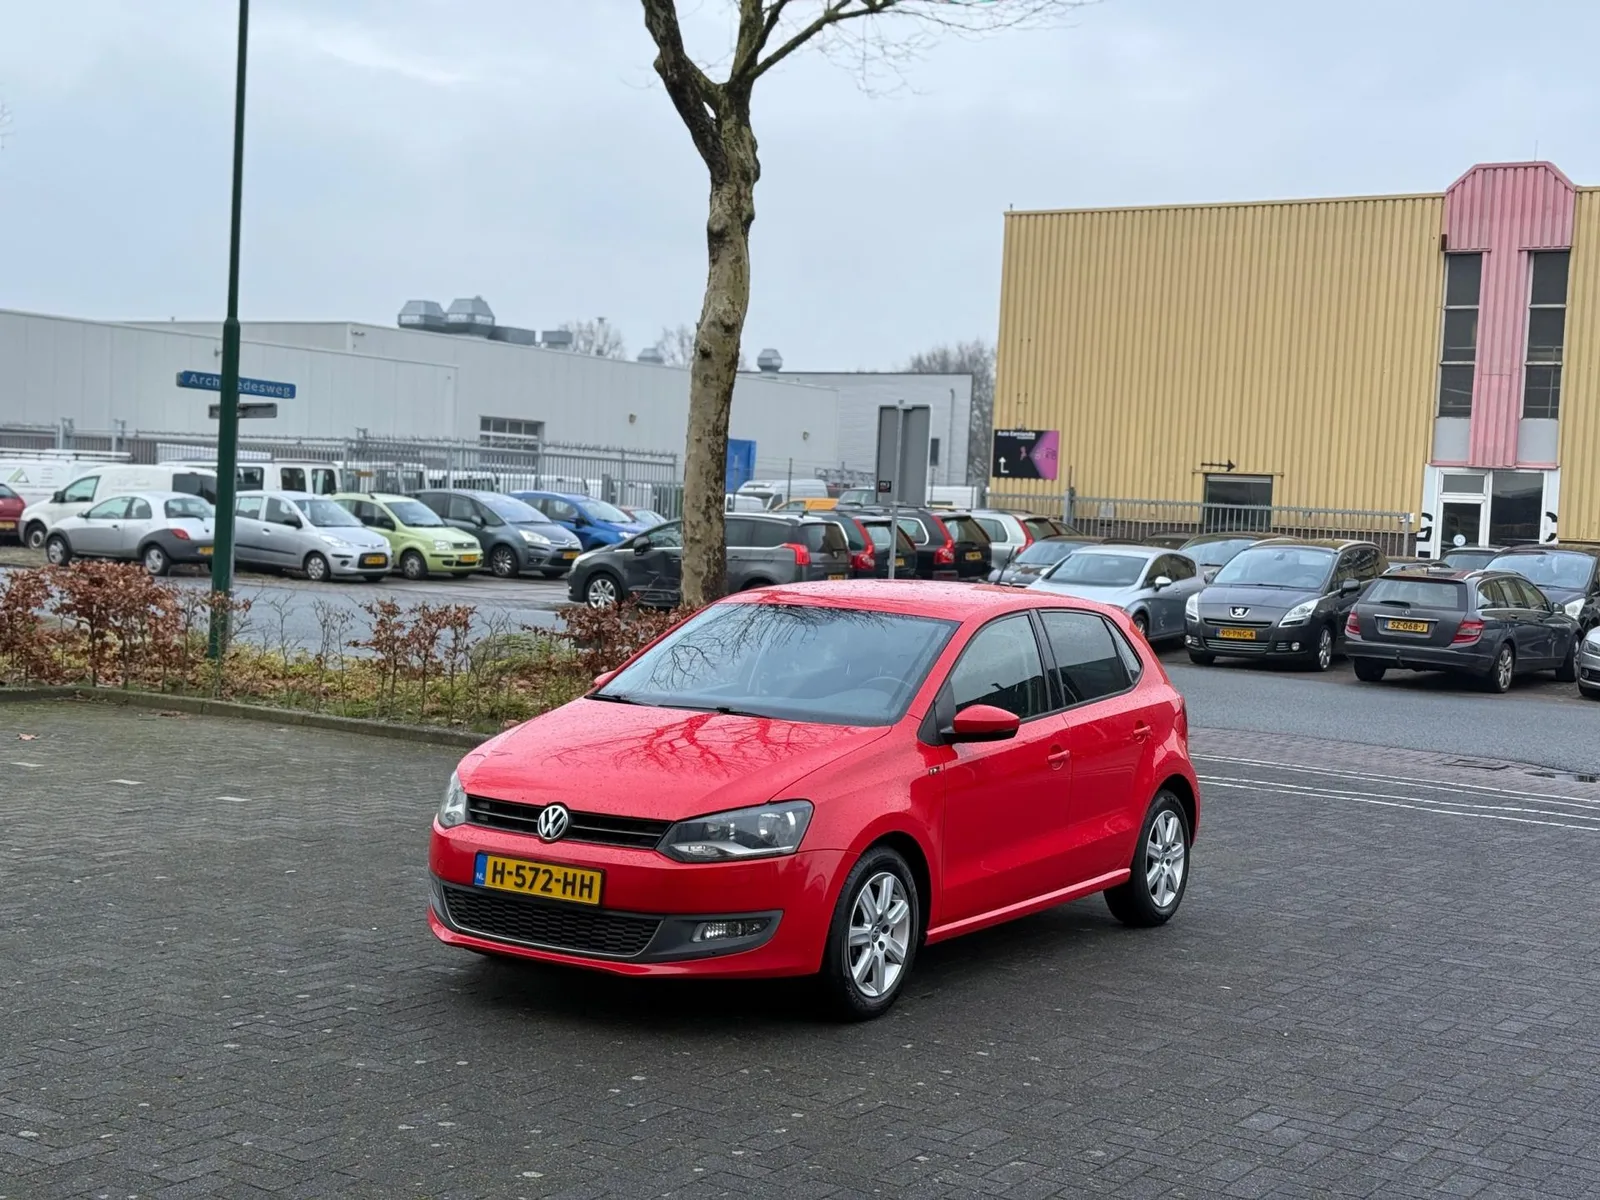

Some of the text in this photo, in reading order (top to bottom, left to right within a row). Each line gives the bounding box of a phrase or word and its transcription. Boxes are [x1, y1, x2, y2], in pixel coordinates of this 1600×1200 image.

[188, 373, 291, 398] Archedesweg
[1391, 621, 1425, 631] SZ-068-J
[476, 872, 484, 881] NL
[491, 861, 594, 899] H-572-HH
